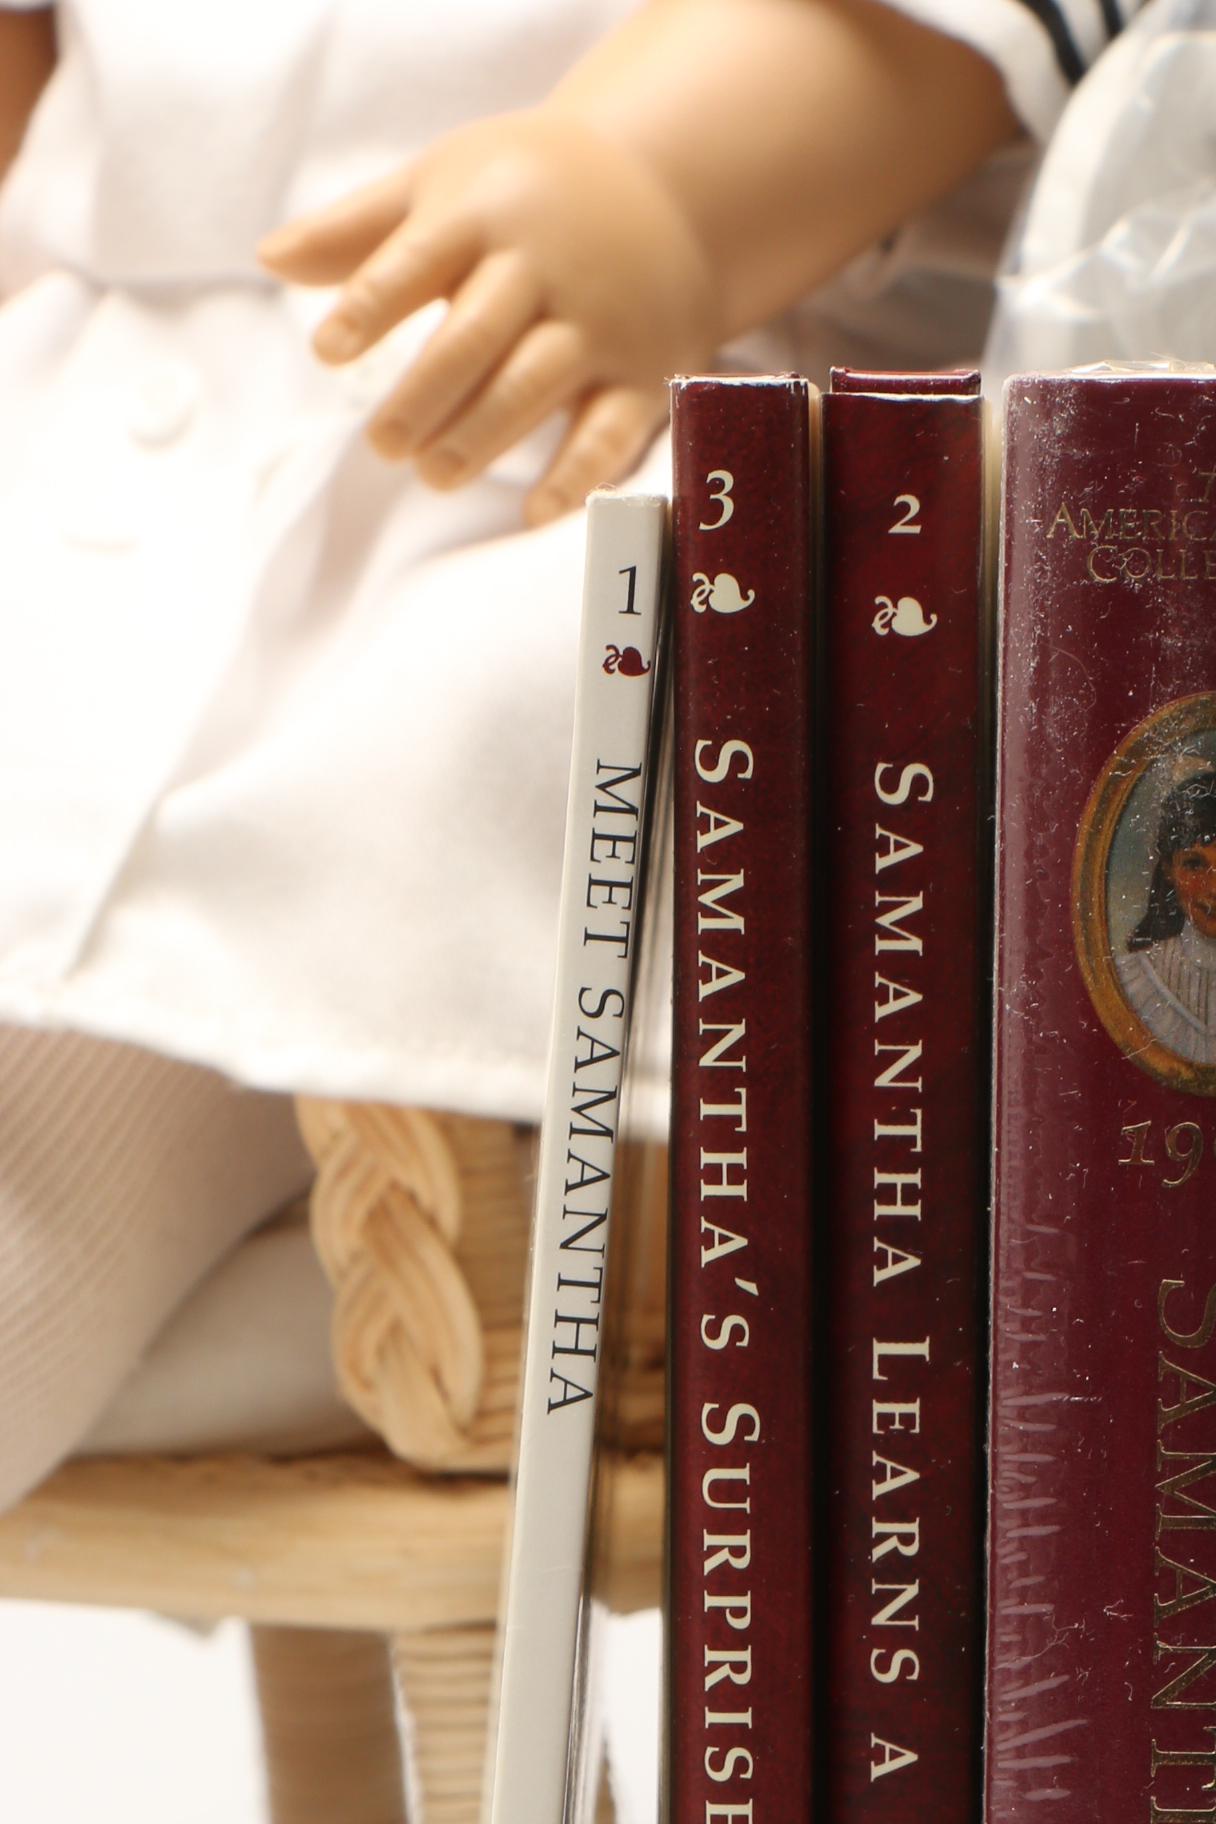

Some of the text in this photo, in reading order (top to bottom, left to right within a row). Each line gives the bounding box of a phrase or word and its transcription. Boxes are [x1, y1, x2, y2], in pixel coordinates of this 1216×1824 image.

[619, 566, 641, 615] 1
[699, 470, 733, 530] 3
[889, 495, 921, 533] 2
[548, 758, 646, 1415] MEET SAMANTHA
[695, 740, 758, 1350] SAMANTHA'S
[874, 763, 933, 1286] SAMANTHA
[871, 1336, 929, 1683] LEARNS
[871, 1733, 918, 1782] A
